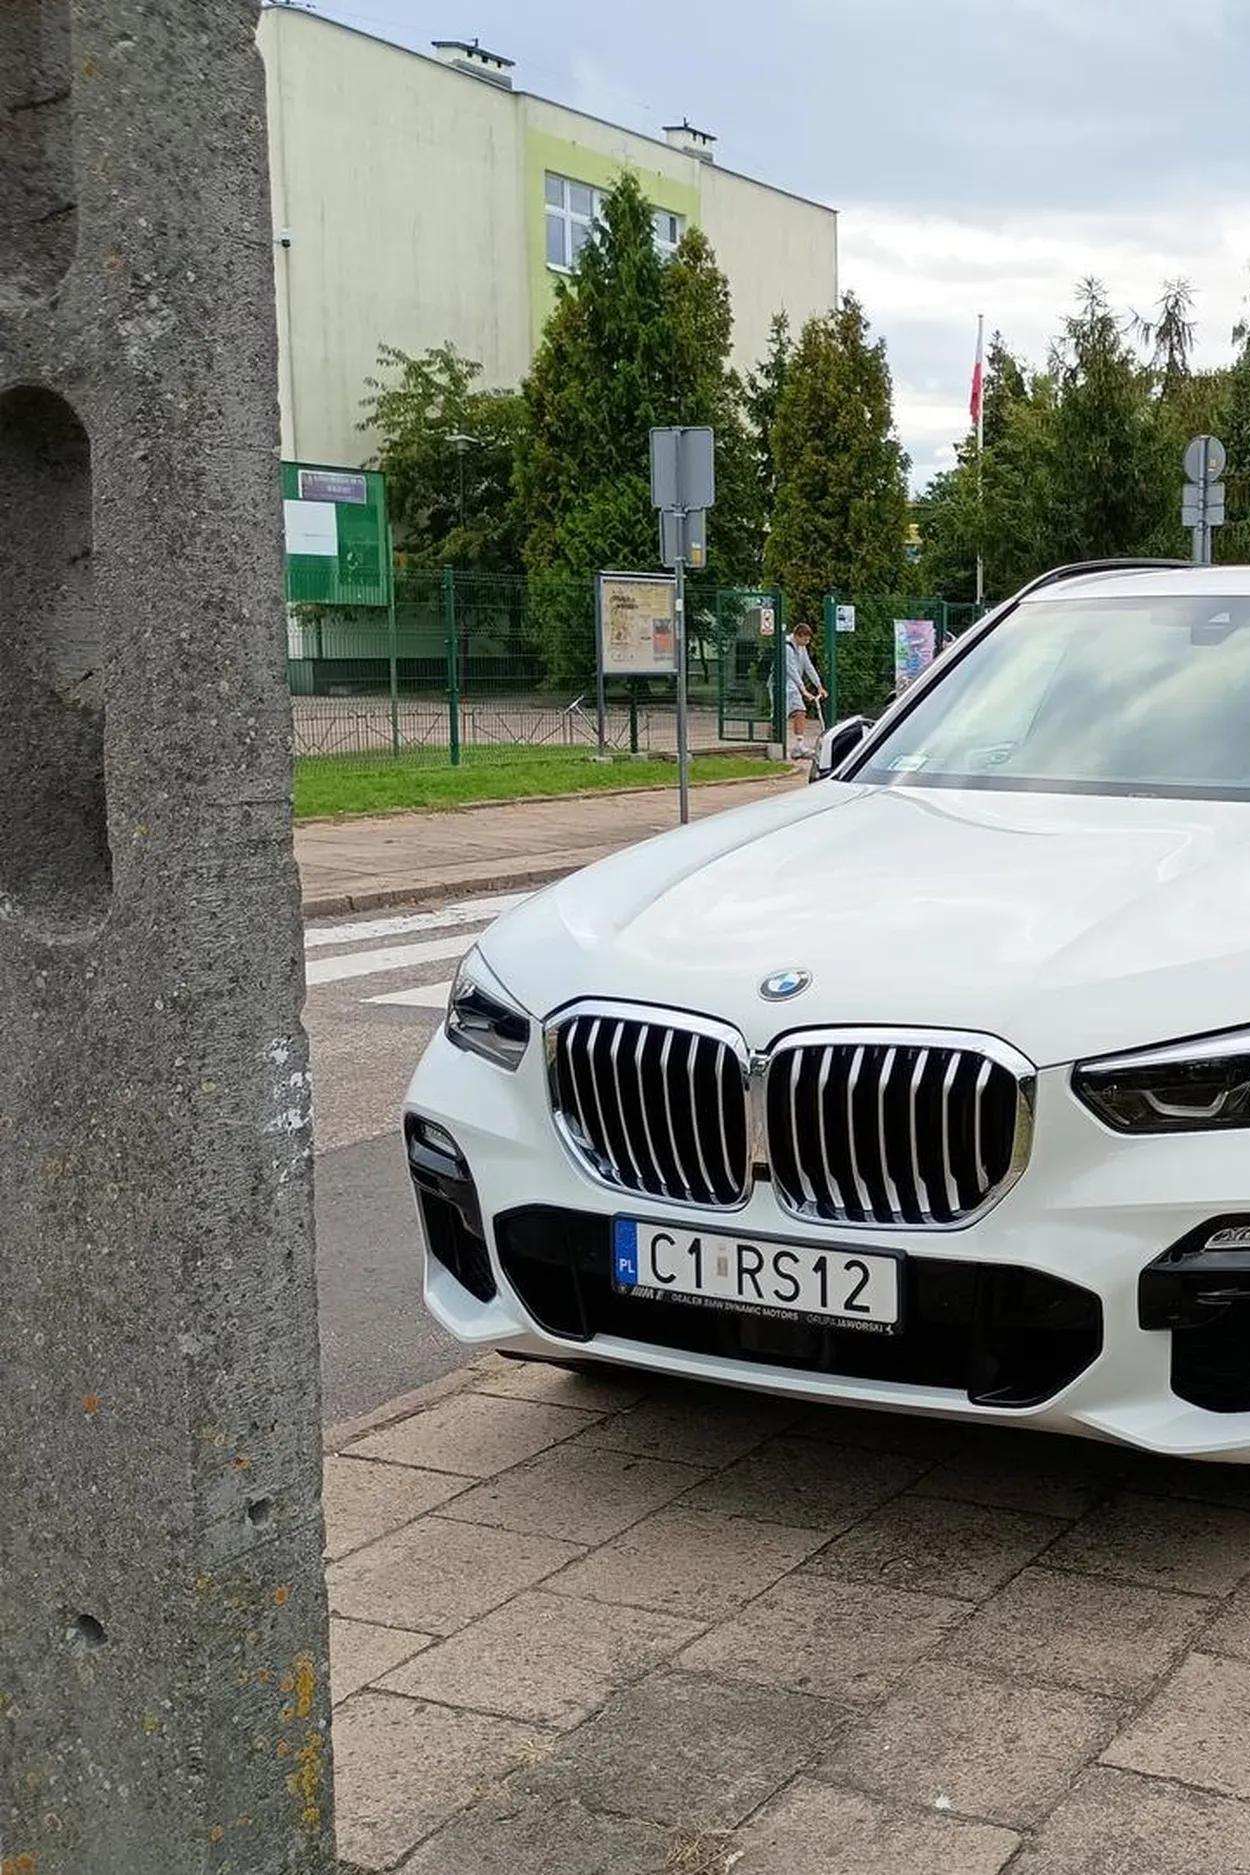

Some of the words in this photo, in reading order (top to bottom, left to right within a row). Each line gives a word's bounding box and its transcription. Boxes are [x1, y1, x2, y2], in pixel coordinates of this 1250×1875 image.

[619, 1258, 635, 1273] PL
[650, 1233, 702, 1289] C1
[736, 1243, 871, 1314] RS12
[725, 1302, 762, 1315] DYNAMIC
[763, 1308, 798, 1321] MOTORS
